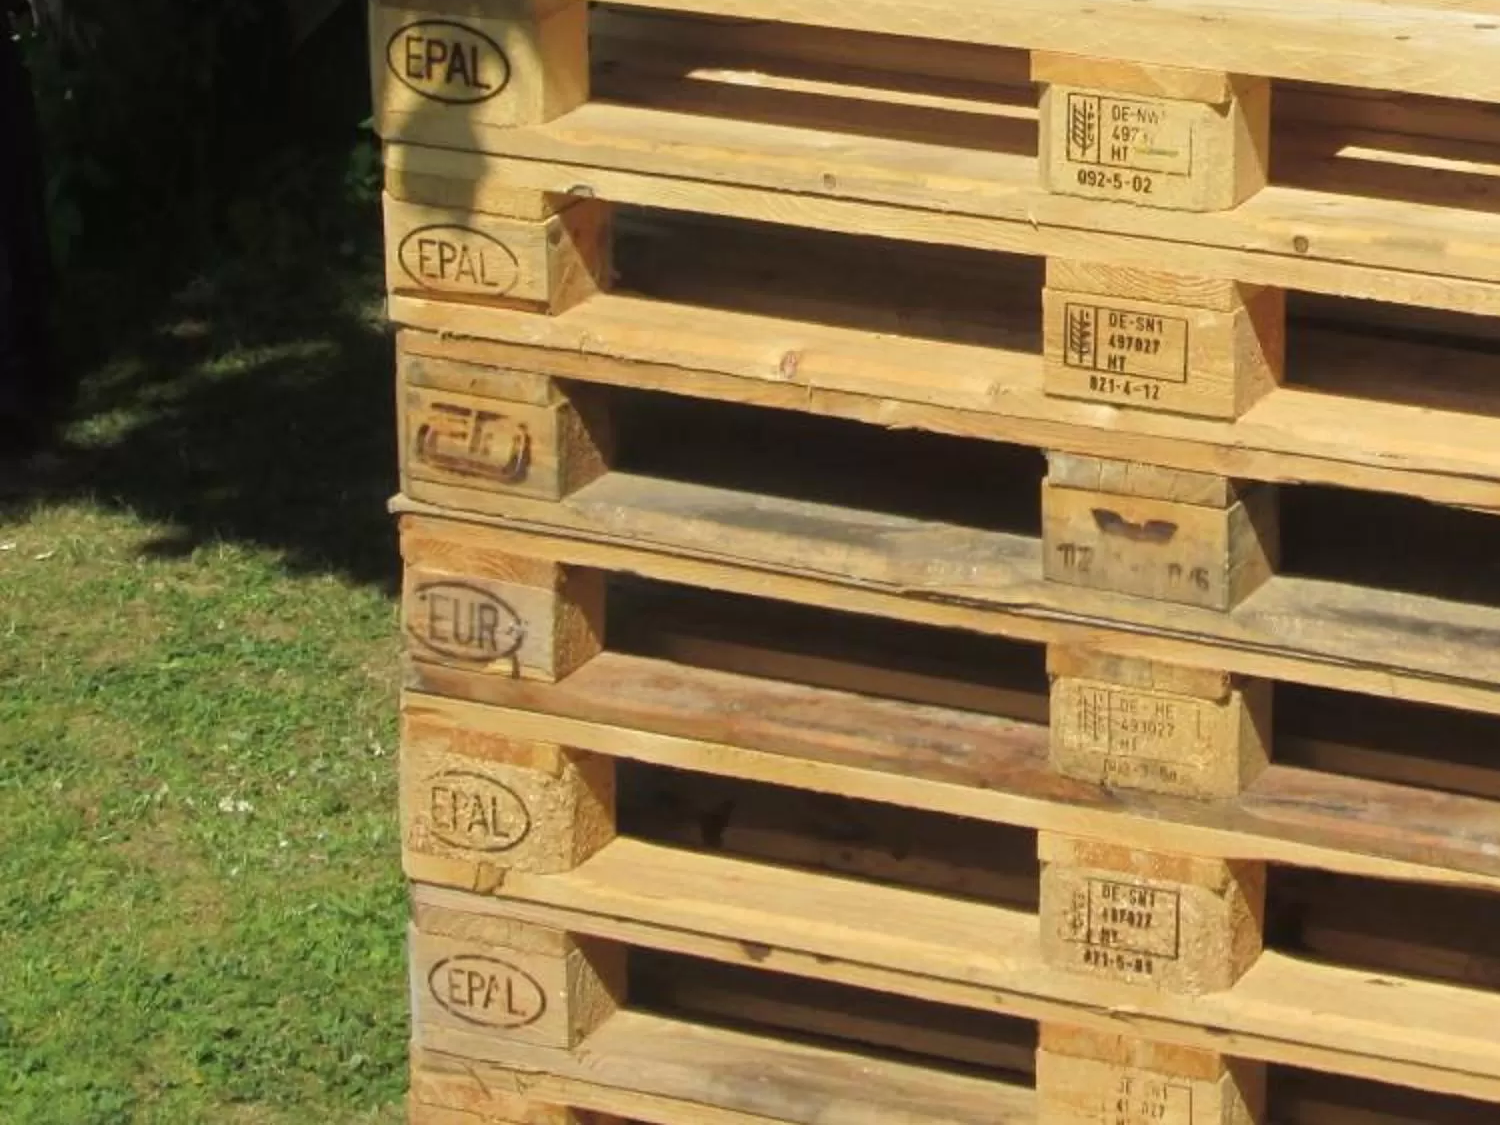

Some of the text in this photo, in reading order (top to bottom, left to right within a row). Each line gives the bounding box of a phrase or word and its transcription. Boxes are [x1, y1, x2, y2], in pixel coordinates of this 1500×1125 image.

[405, 36, 491, 89] EPAL
[1111, 143, 1129, 162] HT
[1077, 168, 1153, 194] 092-5-02
[418, 239, 498, 288] EPAL
[428, 593, 498, 652] EUR
[431, 786, 510, 839] EPAL
[448, 968, 526, 1016] EPAL
